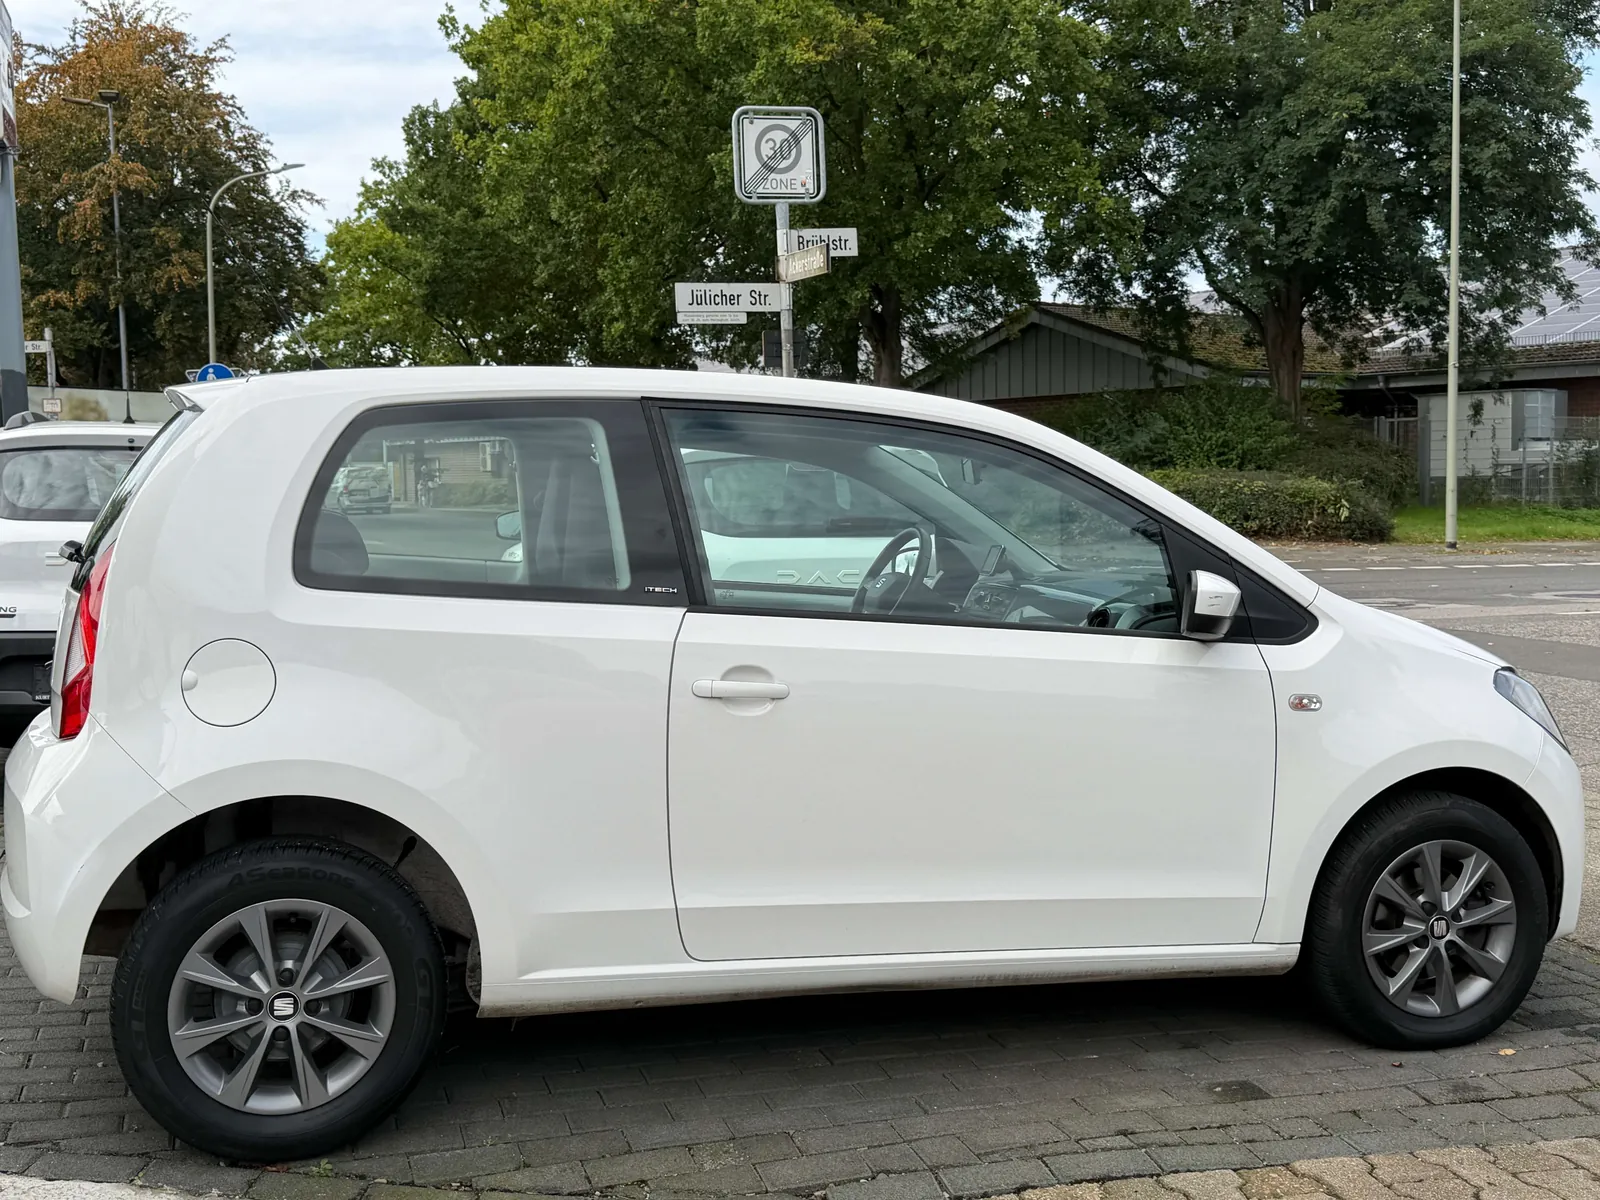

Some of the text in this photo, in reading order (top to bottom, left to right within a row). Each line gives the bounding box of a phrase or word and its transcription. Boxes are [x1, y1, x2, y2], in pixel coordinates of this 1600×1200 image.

[764, 137, 793, 161] 30
[762, 178, 798, 191] ZONE
[688, 289, 772, 306] Jülicher Str.
[776, 569, 861, 585] DAC
